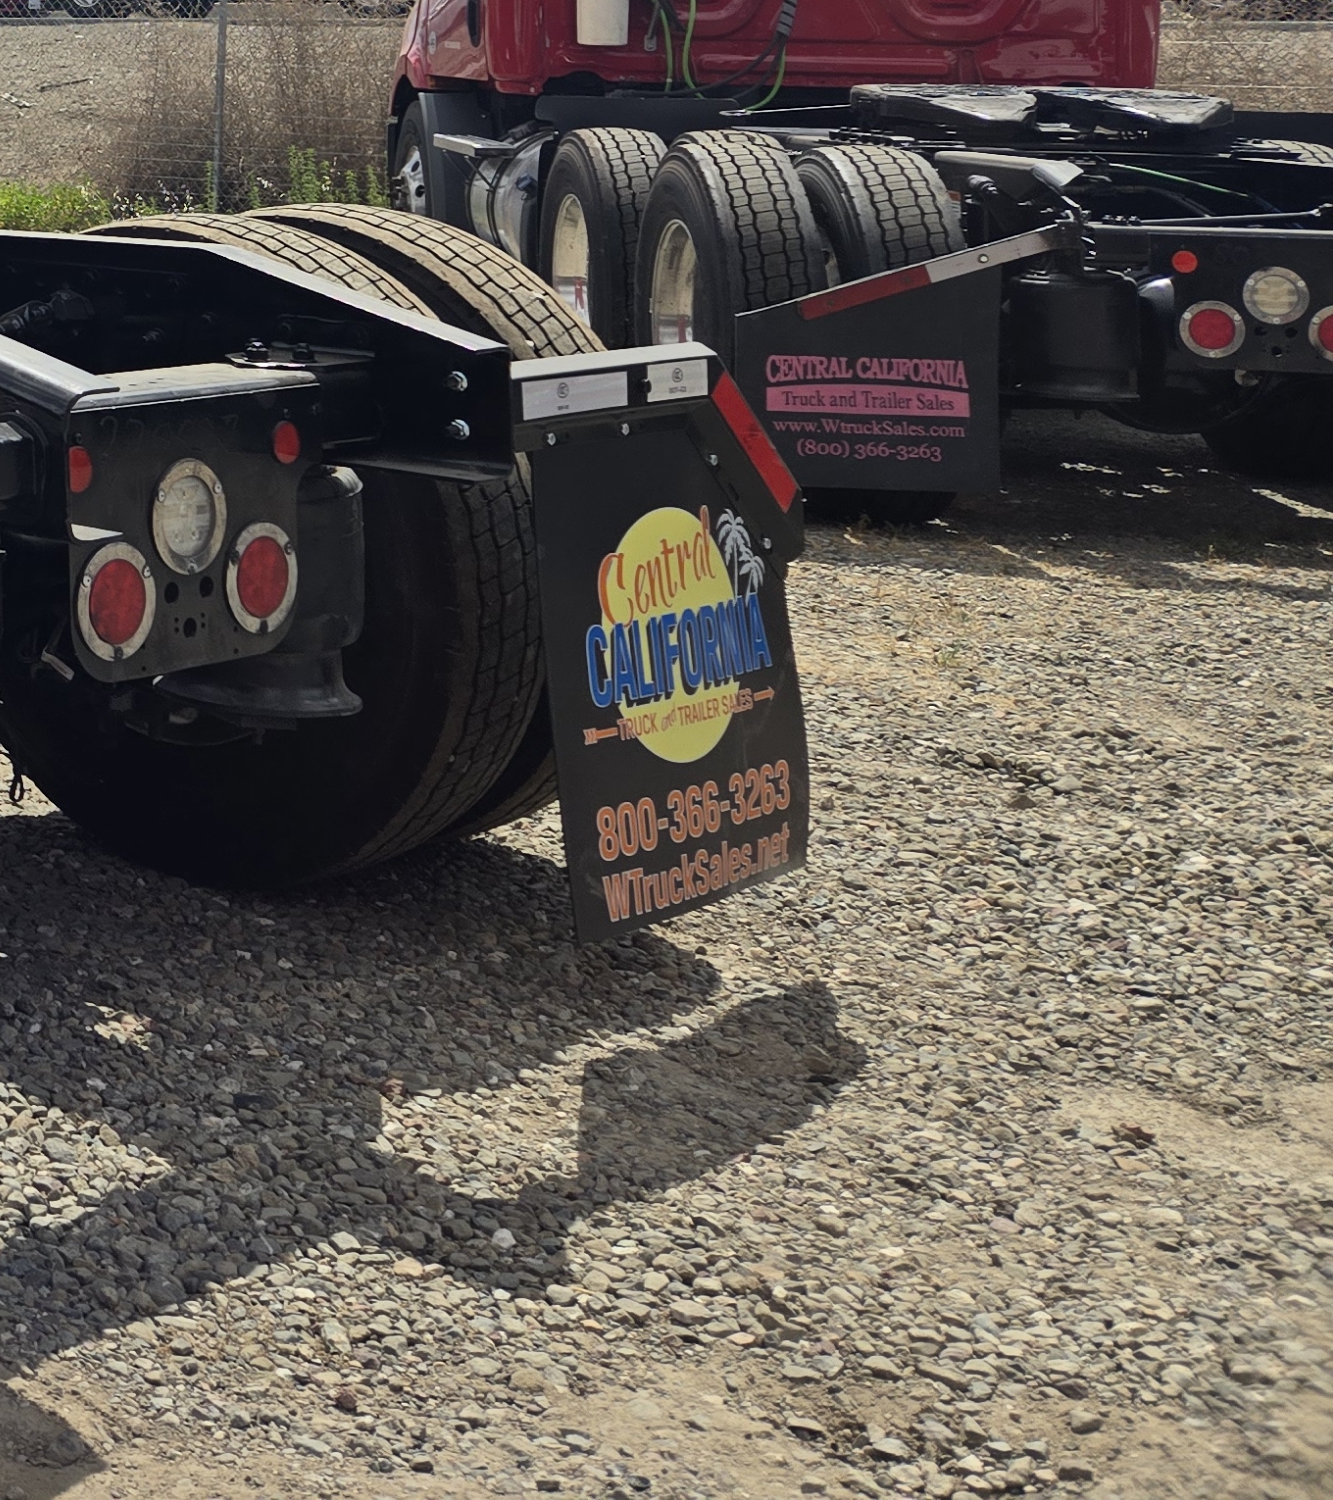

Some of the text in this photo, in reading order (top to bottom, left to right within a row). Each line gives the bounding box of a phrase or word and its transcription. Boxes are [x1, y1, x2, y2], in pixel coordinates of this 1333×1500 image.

[766, 355, 969, 388] CENTRAL CALIFORNIA
[782, 391, 954, 411] Truck and Trailer Sales
[772, 418, 965, 437] www.WtruckSales.com
[797, 438, 942, 462] (800) 366-3263
[598, 505, 716, 627] Central
[586, 592, 772, 708] CALIFORNIA
[617, 688, 754, 740] TRUCK and TRAILER SALES
[596, 759, 790, 861] 800-366-3263
[602, 822, 790, 922] WTruckSales.net
